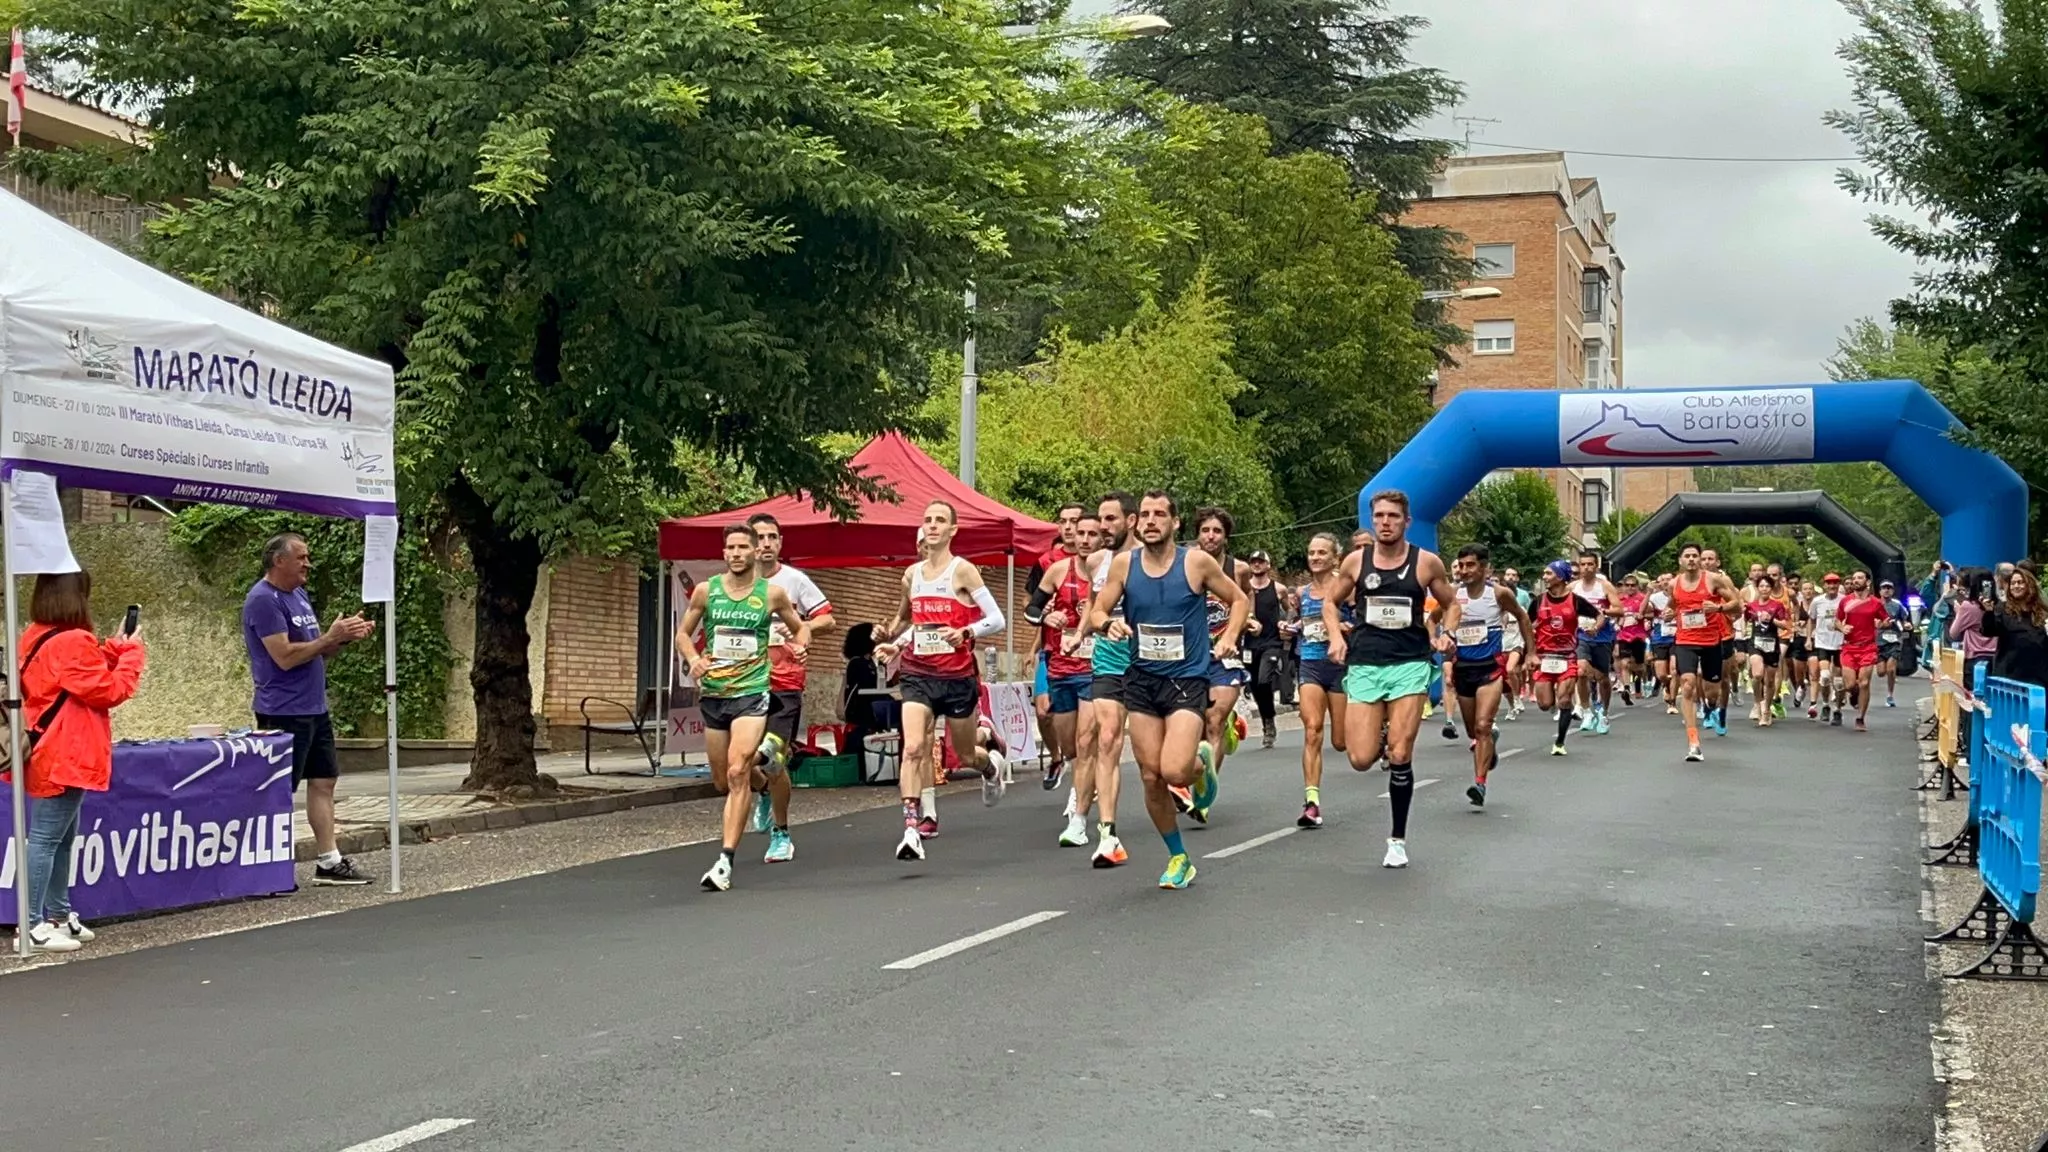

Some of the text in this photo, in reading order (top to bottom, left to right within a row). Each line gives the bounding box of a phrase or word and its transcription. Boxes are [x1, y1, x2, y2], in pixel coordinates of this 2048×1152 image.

[133, 346, 353, 422] MARATÓ LLEIDA
[1683, 393, 1806, 408] Club Atletismo
[96, 404, 116, 417] 2024
[129, 407, 163, 426] Marató
[164, 414, 194, 431] Vithas
[1684, 410, 1807, 431] Barbastro
[12, 431, 58, 448] DISSABTE
[96, 442, 116, 456] 2024
[121, 443, 155, 461] Curses
[202, 454, 232, 471] Curses
[234, 458, 270, 475] Infantils
[711, 608, 760, 622] Huesca
[1382, 608, 1395, 616] 66
[729, 638, 742, 647] 12
[926, 633, 938, 641] 30
[1153, 638, 1167, 647] 32
[672, 716, 687, 736] X
[110, 810, 241, 877] vithas
